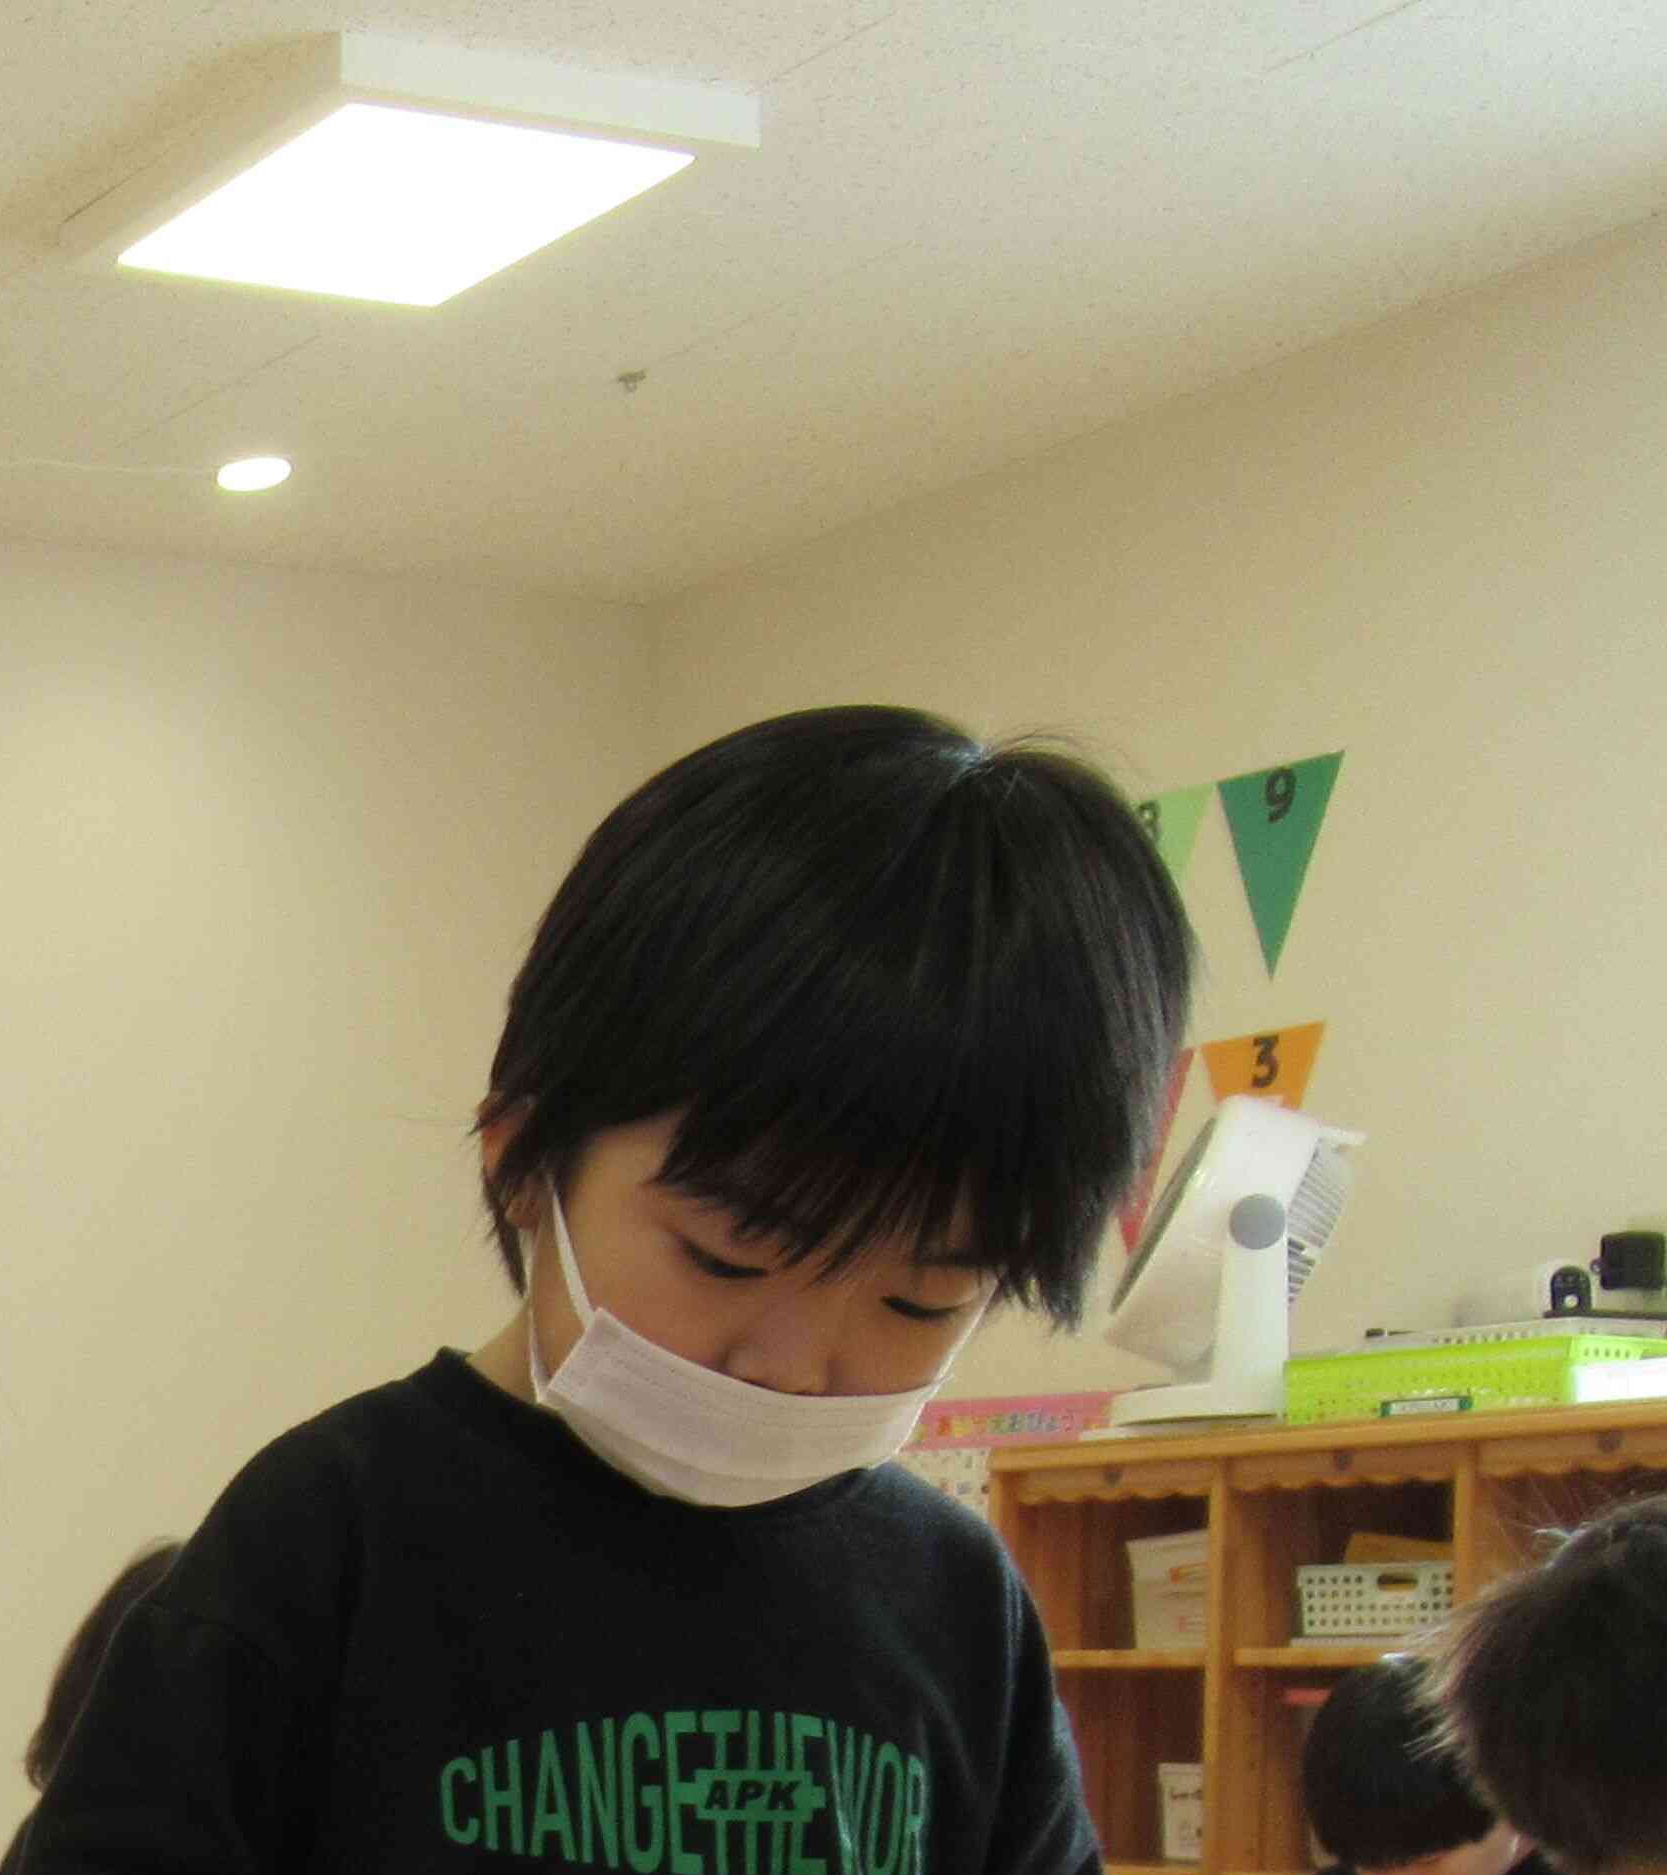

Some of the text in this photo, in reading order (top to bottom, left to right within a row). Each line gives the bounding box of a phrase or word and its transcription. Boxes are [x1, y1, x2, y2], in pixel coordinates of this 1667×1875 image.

[1264, 766, 1297, 824] 9
[1250, 1035, 1280, 1089] 3
[703, 1778, 802, 1813] APK
